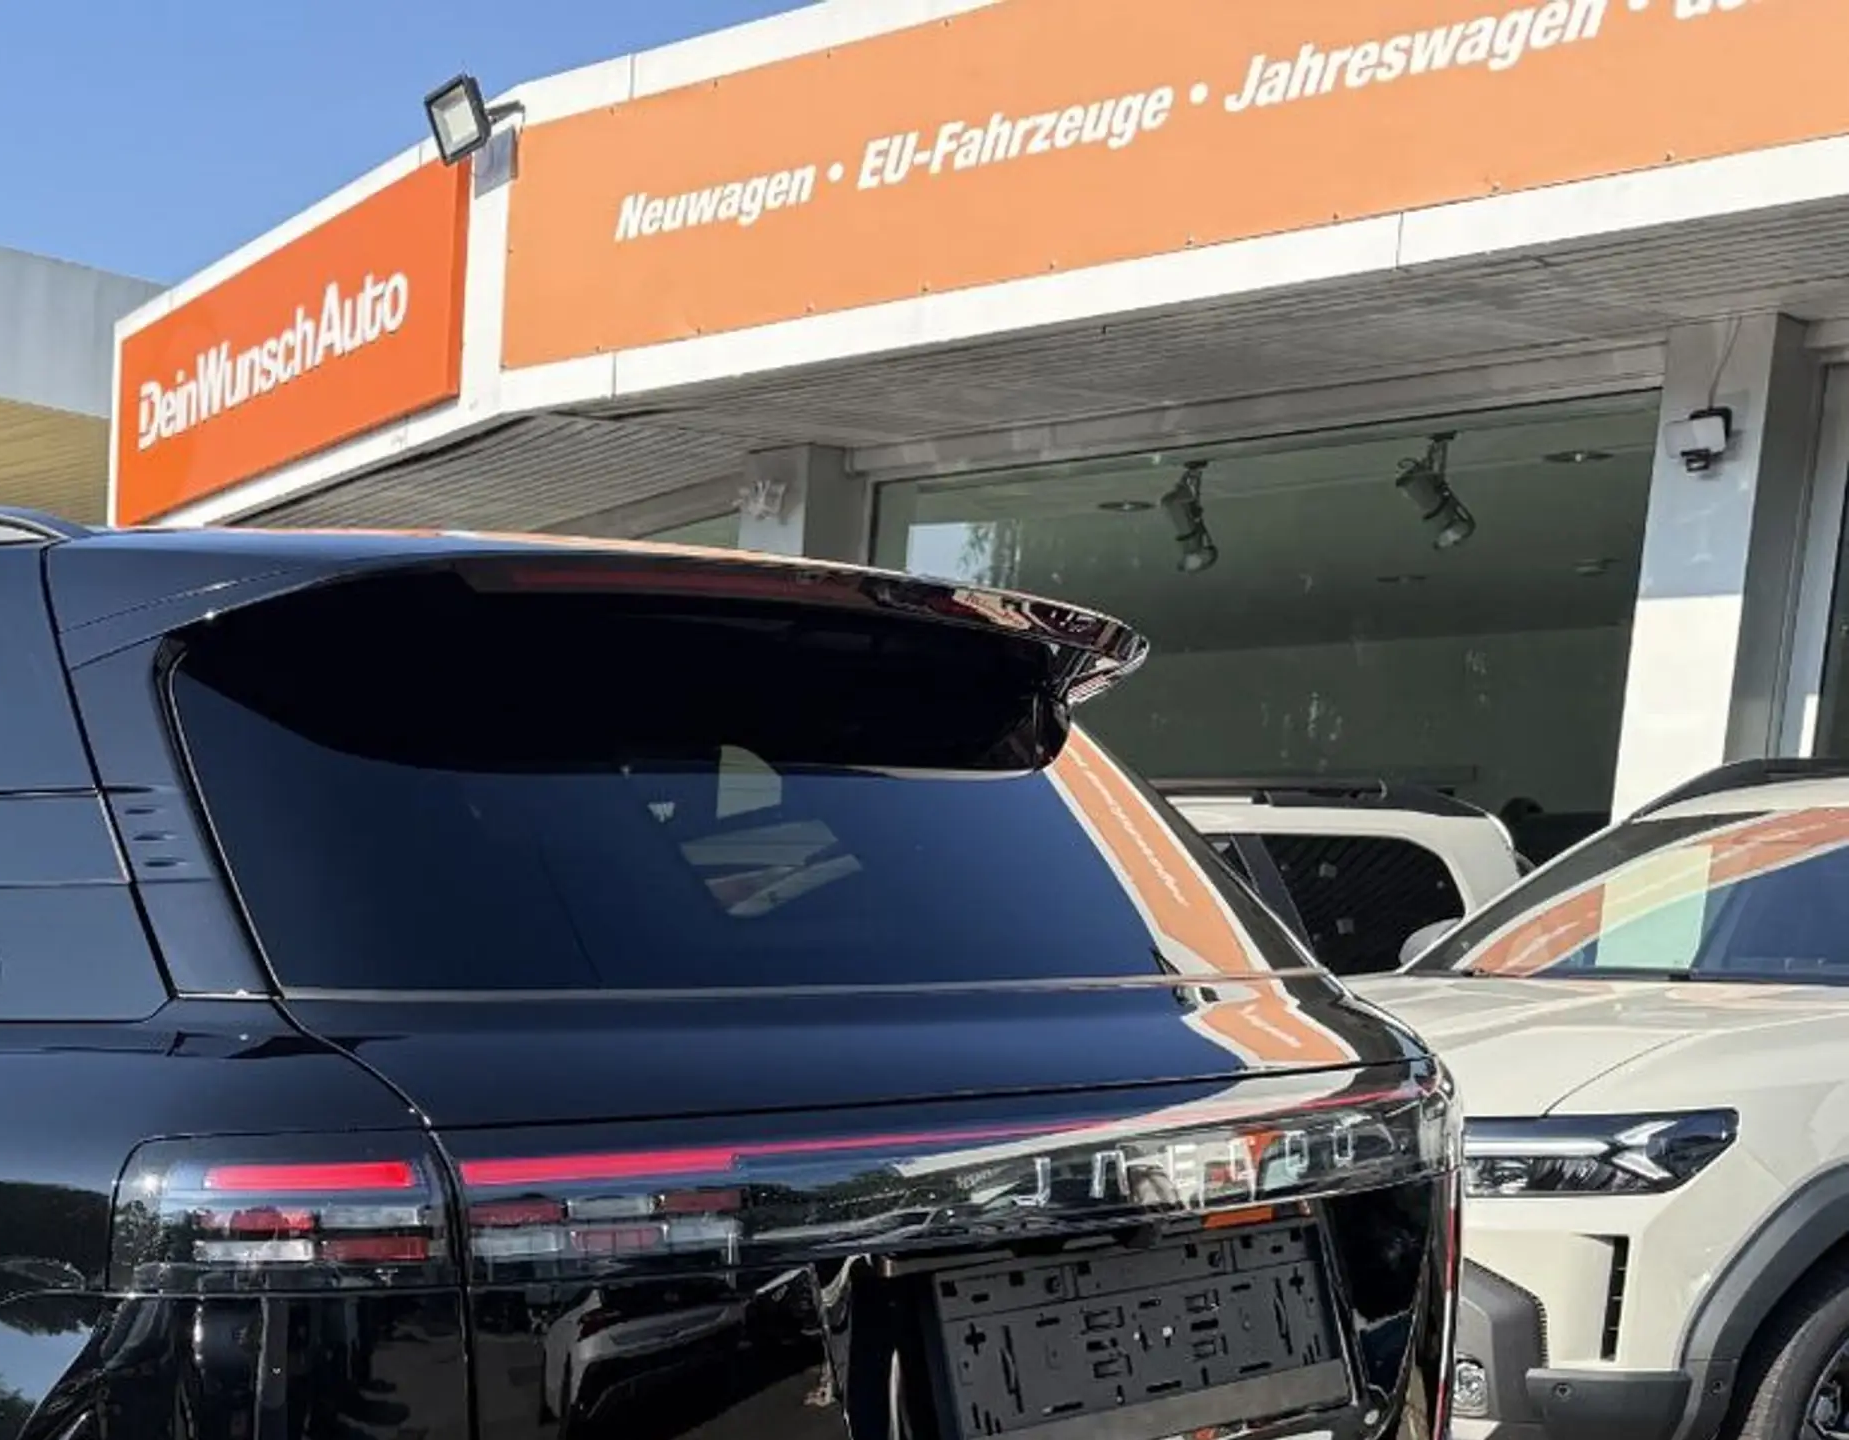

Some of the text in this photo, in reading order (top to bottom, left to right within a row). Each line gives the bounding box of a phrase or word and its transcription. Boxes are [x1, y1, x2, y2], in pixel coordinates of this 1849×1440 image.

[614, 0, 1608, 242] Neuwagen EU-Fahrzeuge Jahreswagen
[137, 271, 409, 450] DeinWunschAuto
